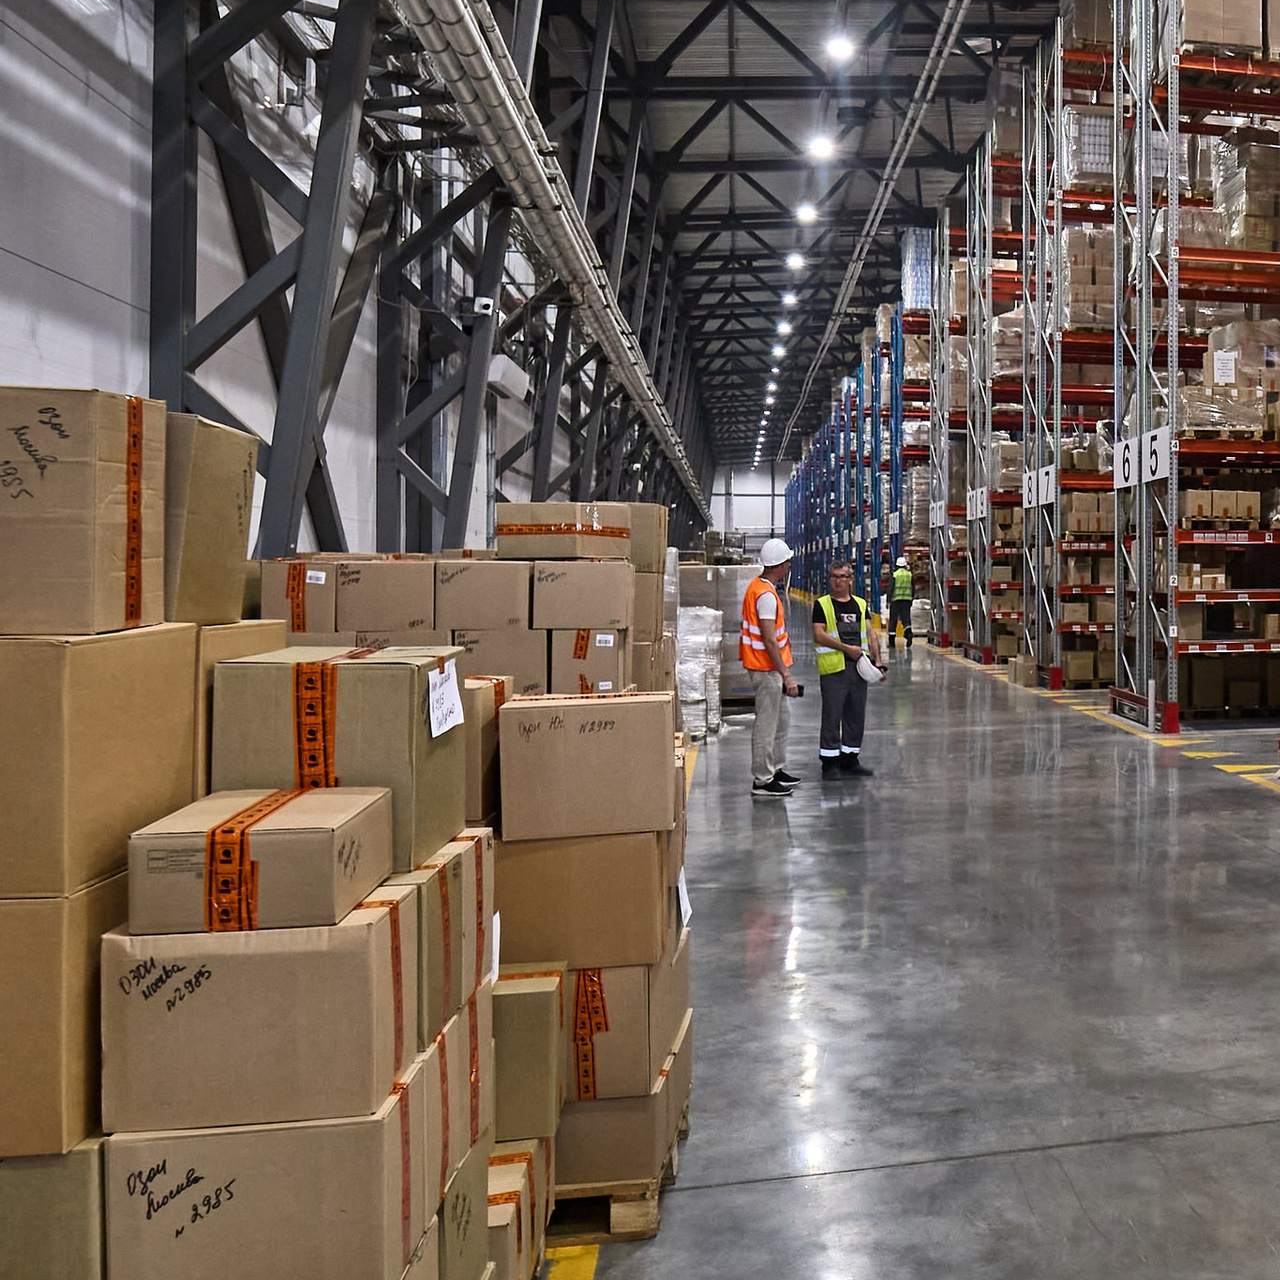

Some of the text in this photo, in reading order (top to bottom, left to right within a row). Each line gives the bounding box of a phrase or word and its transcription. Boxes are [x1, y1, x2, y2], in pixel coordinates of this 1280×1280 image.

[1122, 443, 1131, 483] 6
[1149, 434, 1159, 477] 5
[1027, 475, 1033, 506] 8
[1044, 470, 1050, 503] 7
